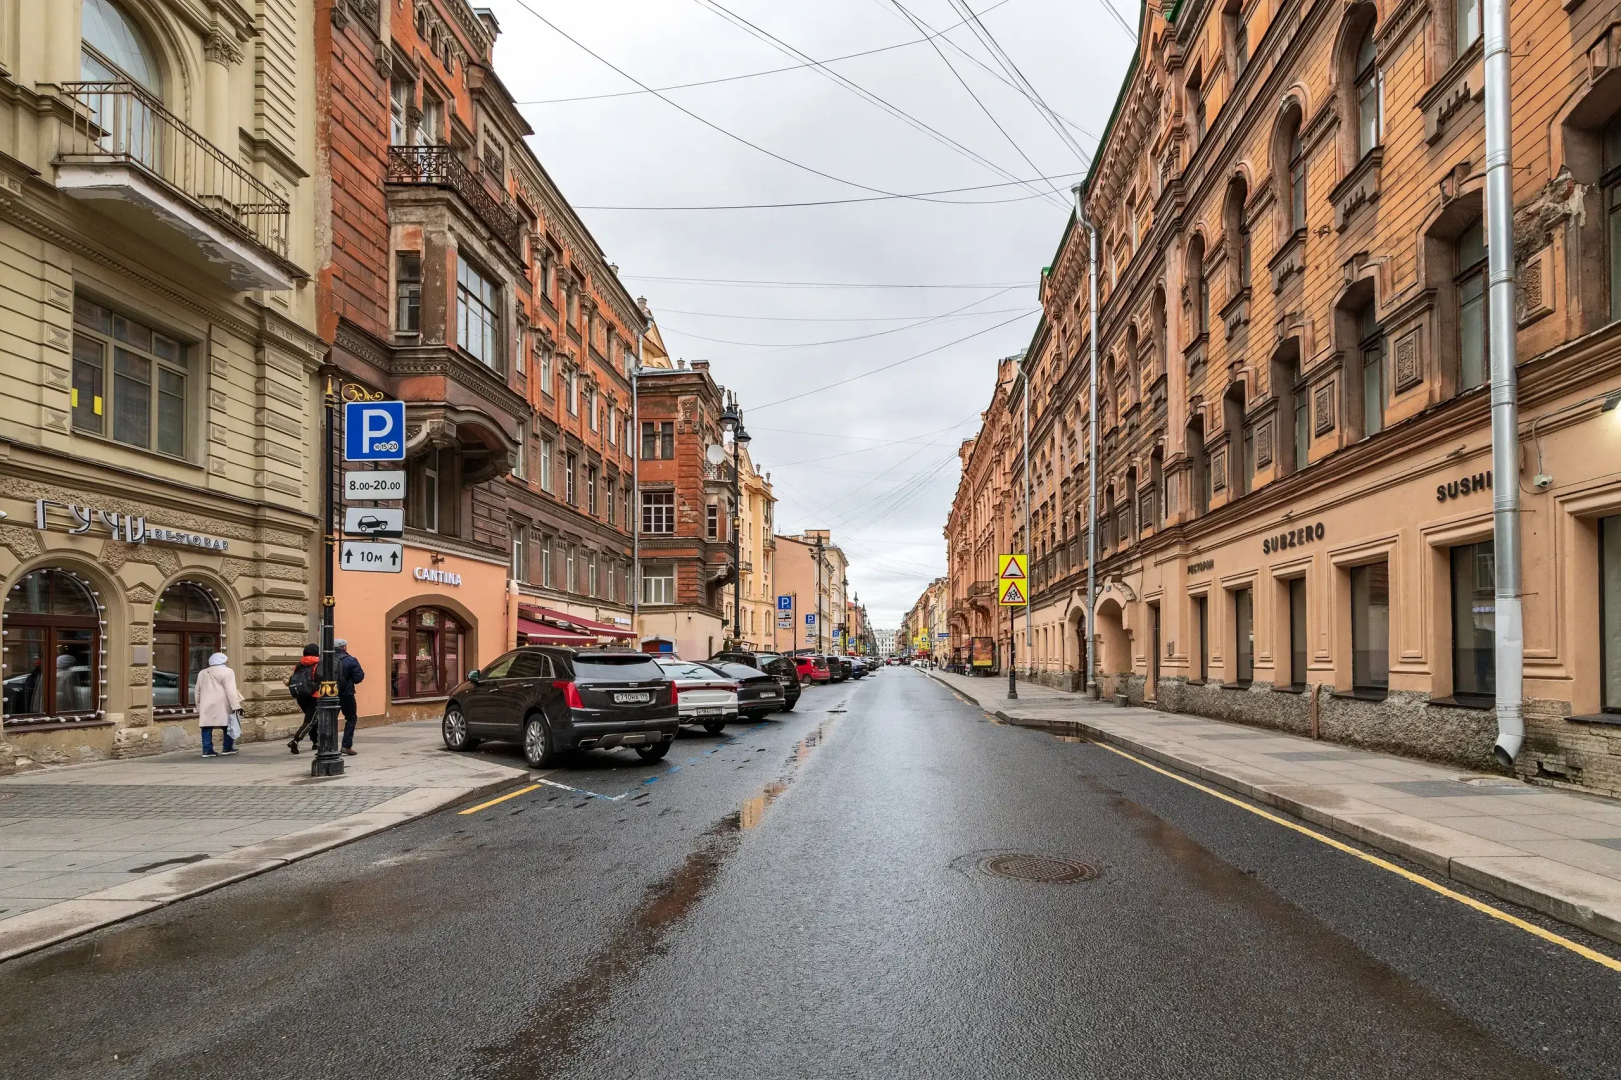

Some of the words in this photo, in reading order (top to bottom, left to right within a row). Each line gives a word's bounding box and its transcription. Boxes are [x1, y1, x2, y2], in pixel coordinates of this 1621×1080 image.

[362, 409, 394, 454] P
[389, 442, 398, 450] 20
[349, 480, 401, 491] 8.00-20.00
[1436, 470, 1493, 502] SUSHI
[151, 528, 229, 550] RESTOBAR
[1263, 521, 1325, 555] SUBZERO
[413, 566, 462, 586] CANTINA
